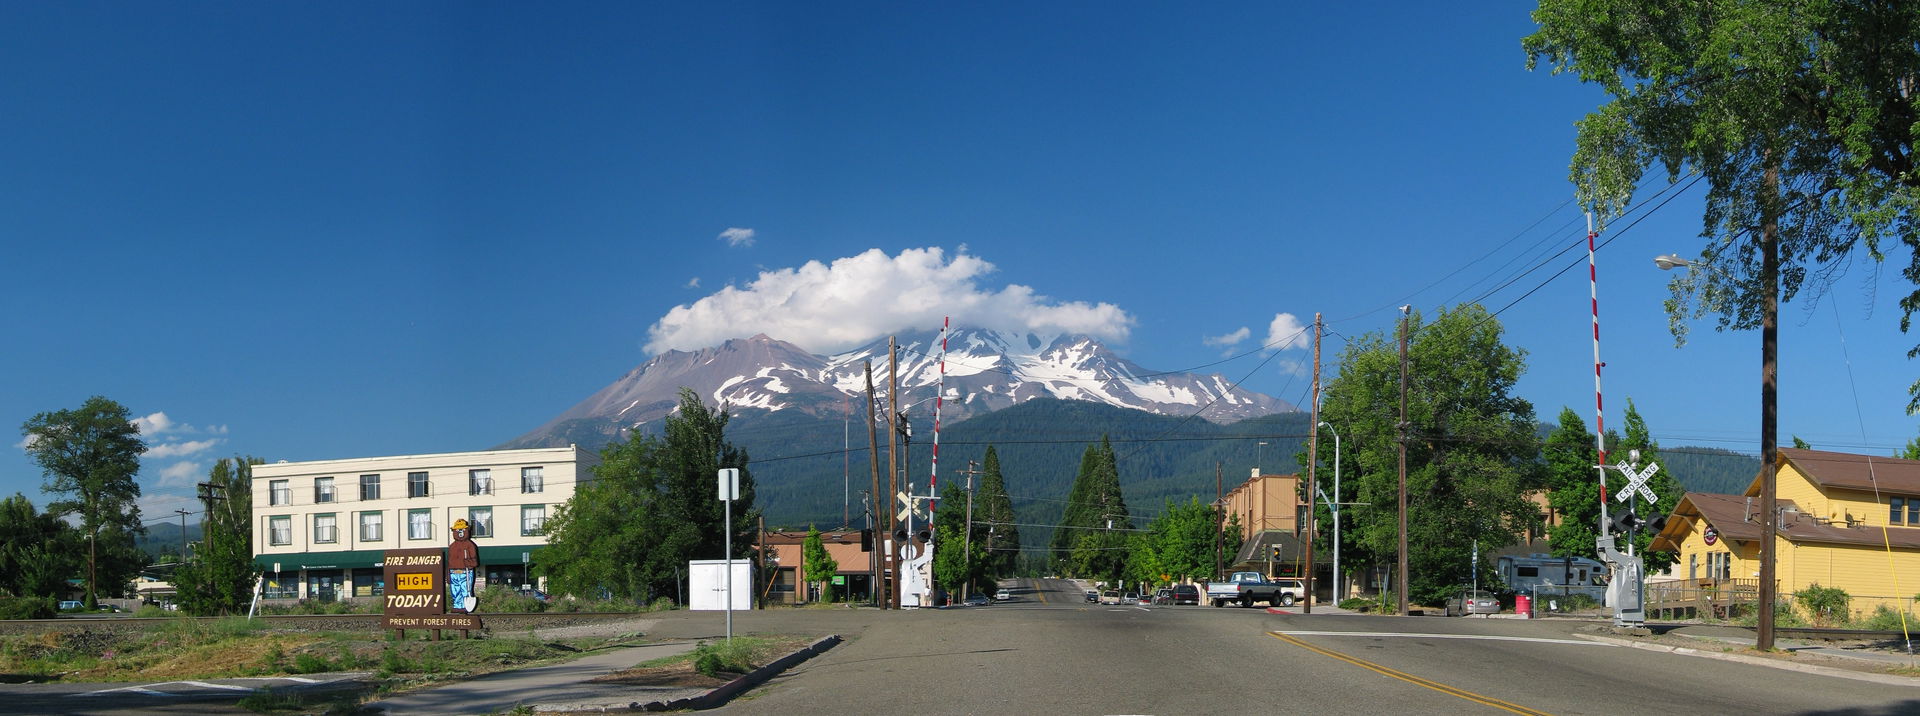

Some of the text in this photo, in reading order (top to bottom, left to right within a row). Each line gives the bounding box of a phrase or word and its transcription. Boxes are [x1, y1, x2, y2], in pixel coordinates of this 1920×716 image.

[1619, 461, 1656, 502] RAIL ROAD
[1620, 465, 1656, 499] CROSSING
[385, 555, 441, 566] FIRE DANGER
[398, 576, 429, 586] HIGH
[389, 618, 472, 626] PREVENT FOREST FIRES
